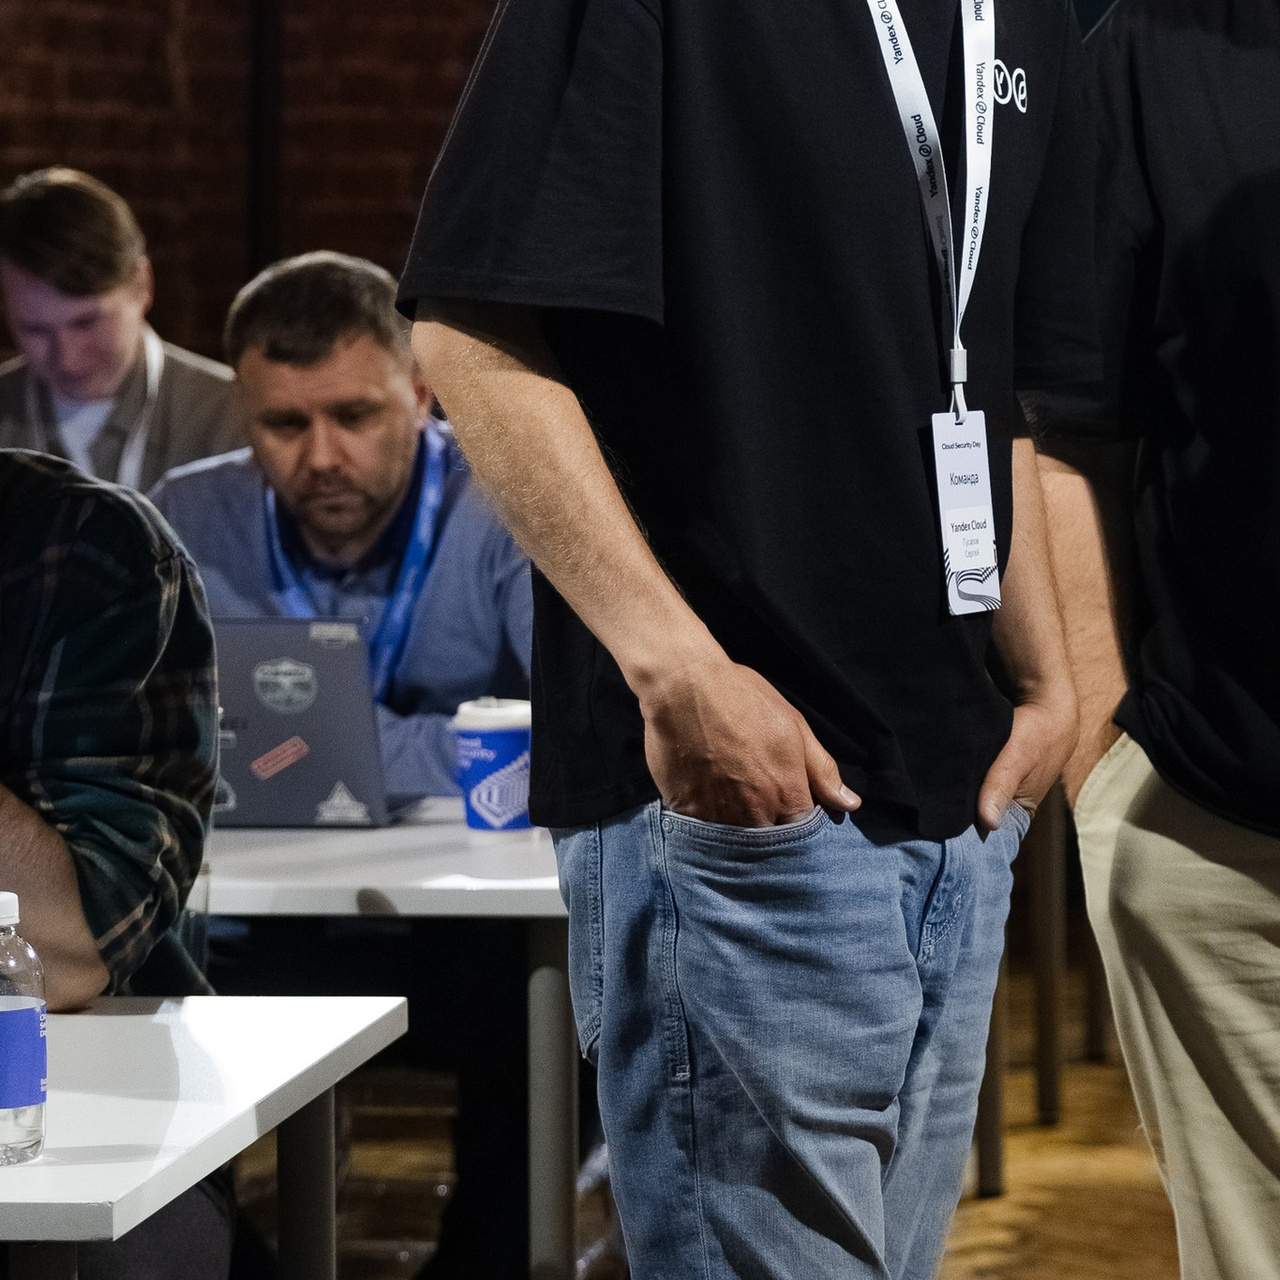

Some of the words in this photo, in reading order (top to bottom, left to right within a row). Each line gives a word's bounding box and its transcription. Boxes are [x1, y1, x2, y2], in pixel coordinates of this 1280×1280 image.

[887, 24, 904, 65] Yandex
[976, 62, 985, 99] Yandex
[911, 114, 927, 143] Cloud
[976, 115, 985, 145] Cloud
[925, 158, 939, 198] Yandex
[973, 186, 983, 224] Yandex
[968, 240, 977, 270] Cloud
[950, 472, 979, 486] Команда
[950, 521, 971, 533] Yandex
[971, 518, 987, 530] Cloud
